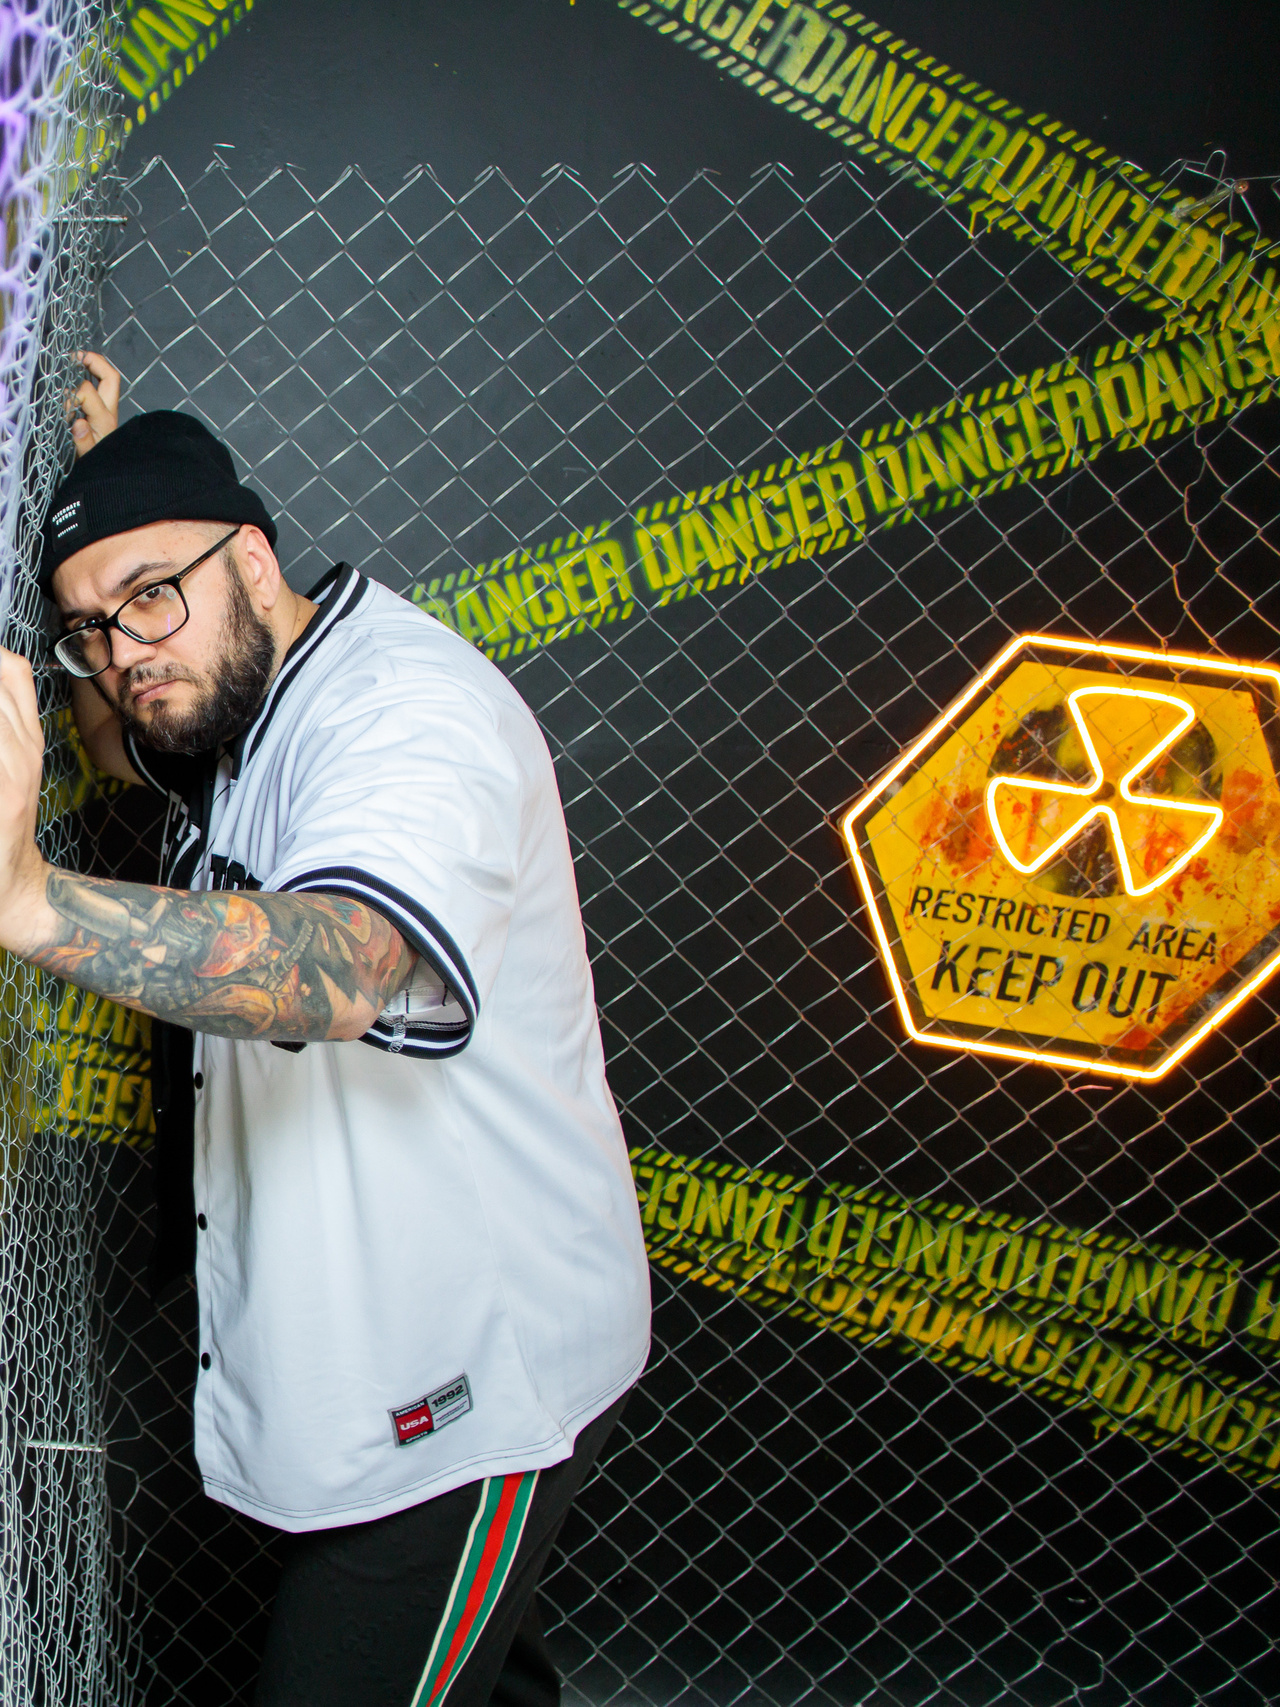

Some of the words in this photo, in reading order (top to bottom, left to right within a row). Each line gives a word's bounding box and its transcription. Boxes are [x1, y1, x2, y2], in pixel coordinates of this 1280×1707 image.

[112, 0, 230, 100] DAN
[780, 18, 1009, 190] DANGER
[980, 128, 1210, 298] DANGER
[634, 460, 867, 582] DANGER
[860, 376, 1102, 514] DANGER
[1094, 326, 1280, 440] DANG
[910, 884, 1112, 945] RESTRICTED
[1127, 920, 1218, 965] AREA
[930, 939, 1065, 1006] KEEP
[1071, 960, 1180, 1024] OUT
[631, 1163, 807, 1252] DANGE
[906, 1295, 1123, 1400] DANGER
[400, 1415, 429, 1431] USA
[431, 1384, 465, 1408] 1992
